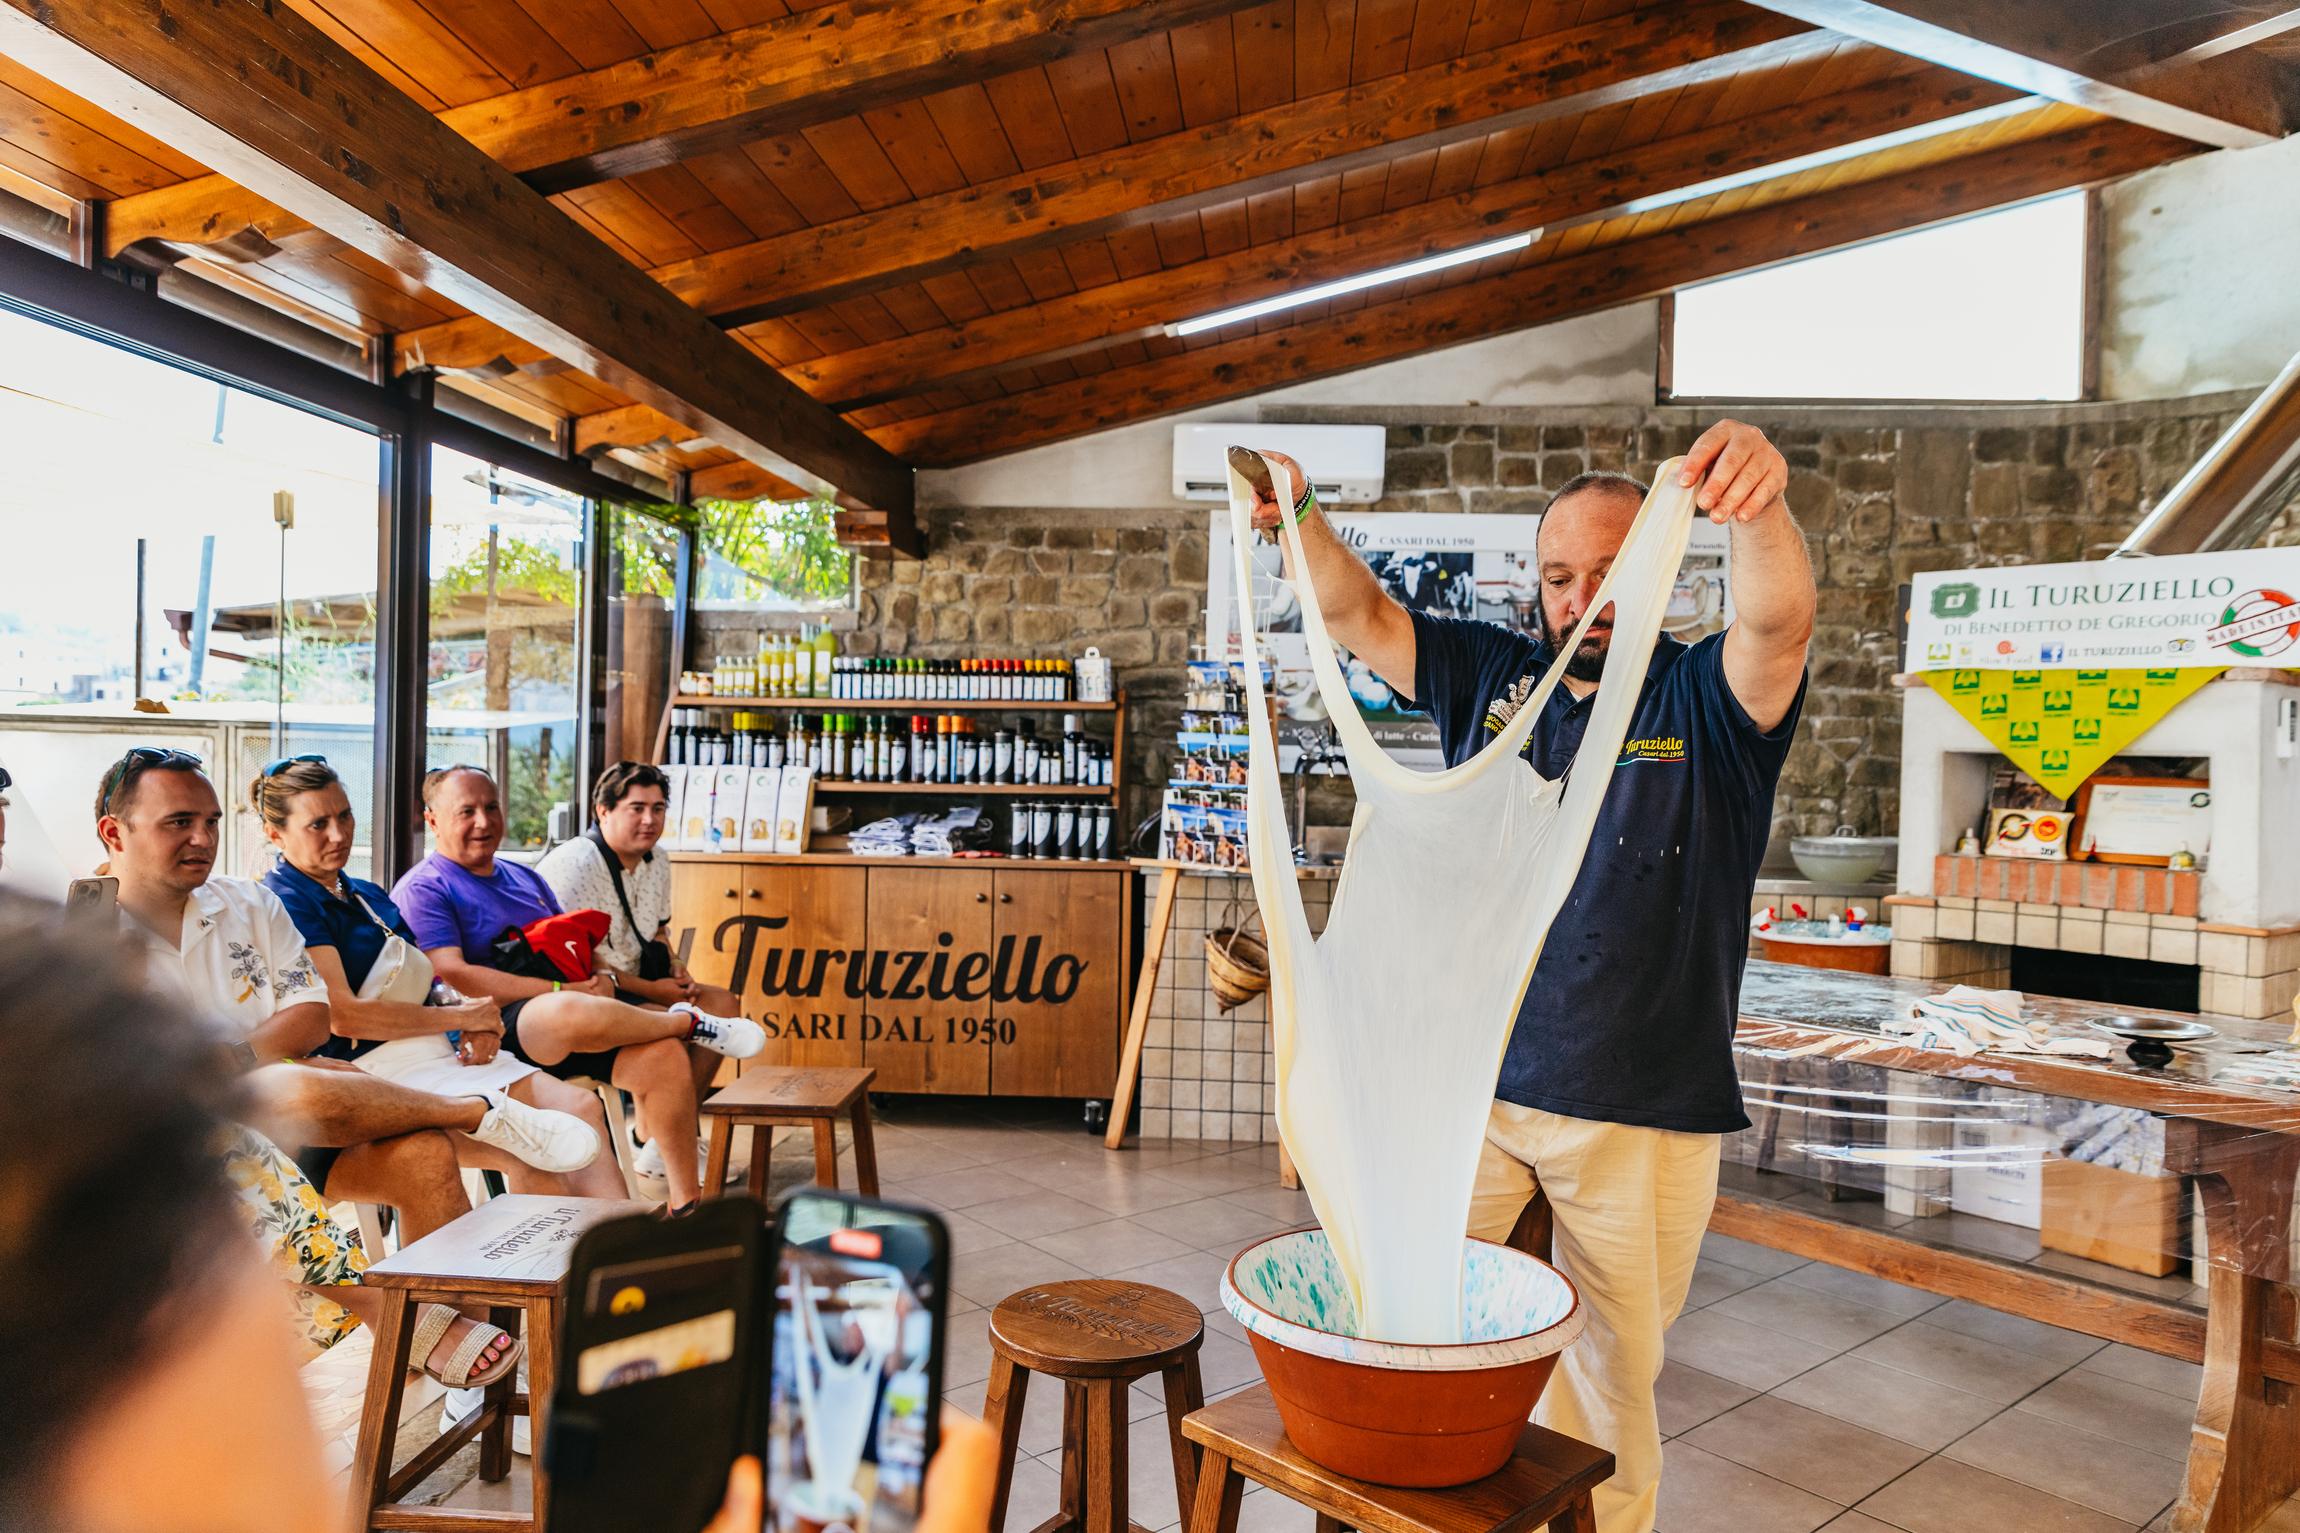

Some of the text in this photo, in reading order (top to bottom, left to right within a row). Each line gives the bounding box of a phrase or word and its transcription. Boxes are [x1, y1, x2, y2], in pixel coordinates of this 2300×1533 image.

[1379, 537, 1475, 546] CASARI DAL 1950
[1989, 576, 2234, 608] IL TURUZIELLO
[1944, 612, 2218, 636] DI BENEDETTO DE GREGORIO
[2207, 625, 2245, 642] MADE
[2250, 620, 2266, 630] IN
[2084, 645, 2163, 656] TURUZIELLO
[1626, 736, 1683, 755] Turuziello
[713, 915, 1089, 1004] Turuziello
[745, 1012, 1016, 1045] SARI DAL 1950
[483, 1215, 573, 1260] Turuziello
